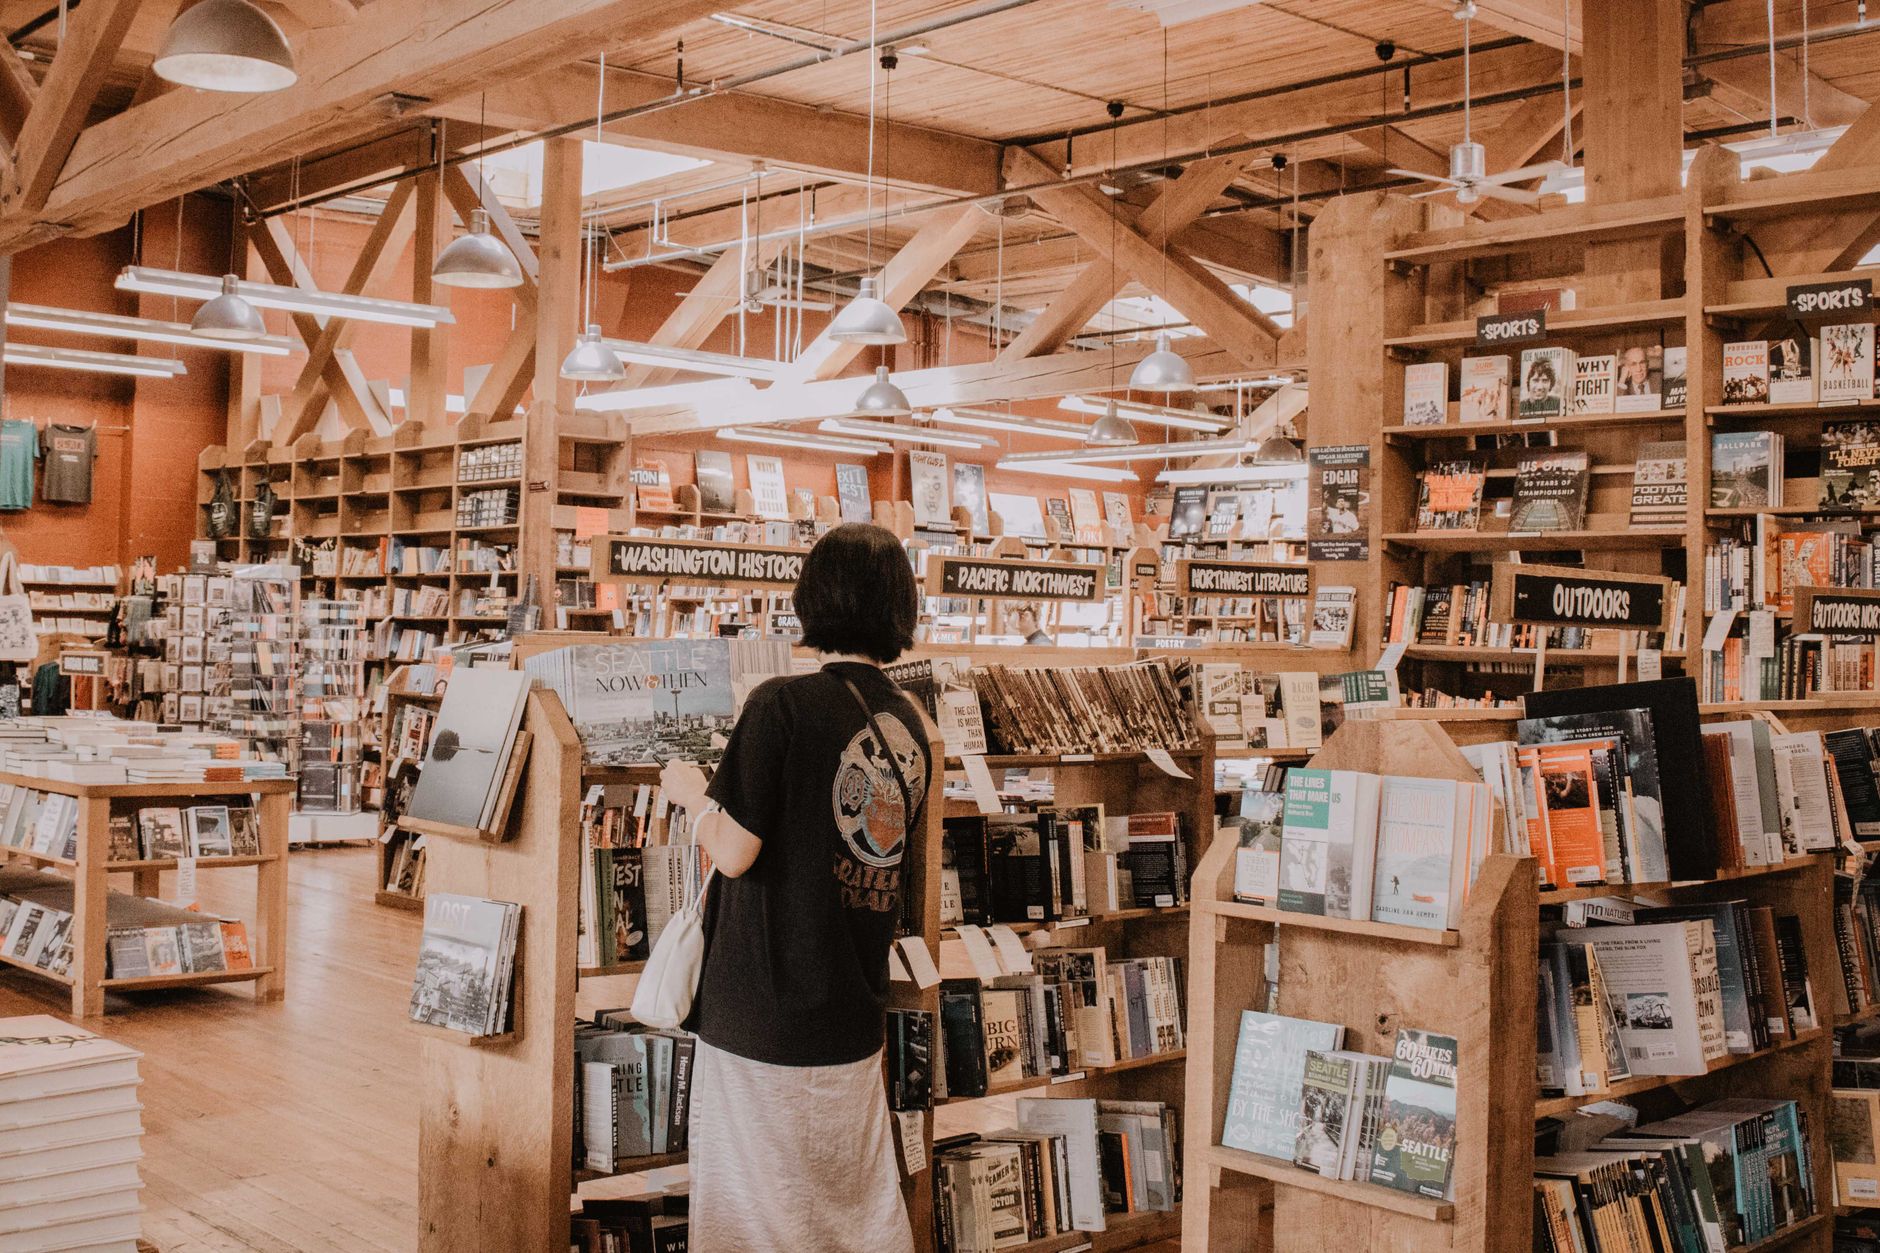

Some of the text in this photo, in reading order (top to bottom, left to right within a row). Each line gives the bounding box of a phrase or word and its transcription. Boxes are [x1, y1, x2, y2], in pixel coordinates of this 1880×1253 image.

[1798, 288, 1863, 311] SPORTS
[1485, 319, 1538, 340] SPORTS
[1522, 352, 1532, 362] JOE
[1725, 355, 1764, 367] ROCK
[1577, 360, 1610, 373] WHY
[1576, 378, 1609, 396] FIGHT
[1823, 379, 1869, 390] BASKETBALL
[1718, 441, 1762, 449] BALLPARK
[1521, 460, 1582, 472] US OPEN
[1838, 457, 1876, 467] FORGET
[1322, 470, 1359, 485] EDGAR
[621, 545, 735, 575] WASHINGTON
[958, 565, 1090, 596] PACIFIC NORTHWEST
[1191, 568, 1308, 593] NORTHWEST LITERATURE
[1552, 583, 1630, 620] OUTDOORS
[1814, 600, 1860, 629] OUTDOORS
[1155, 639, 1185, 648] POETRY
[596, 648, 707, 675] SEATTLE
[596, 671, 708, 693] NOW & THEN
[954, 705, 979, 715] THE CITY
[1215, 703, 1238, 713] DOCTOR
[958, 717, 981, 727] IS MORE
[967, 728, 982, 738] THAN
[963, 740, 984, 750] HUMAN
[1290, 776, 1325, 788] THE LINES
[1289, 790, 1342, 804] THAT MAKE US
[432, 900, 471, 927] LOST
[1605, 906, 1631, 921] NATURE
[986, 1020, 1016, 1035] BIG
[1594, 1000, 1605, 1053] BOULDERING
[1396, 1039, 1452, 1062] 60 HIKES
[1309, 1061, 1348, 1079] SEATTLE
[1411, 1057, 1431, 1078] 60
[674, 1056, 689, 1126] Henry M. Jackson
[1233, 1099, 1248, 1118] BY
[1252, 1102, 1274, 1124] THE
[1401, 1139, 1449, 1162] SEATTLE
